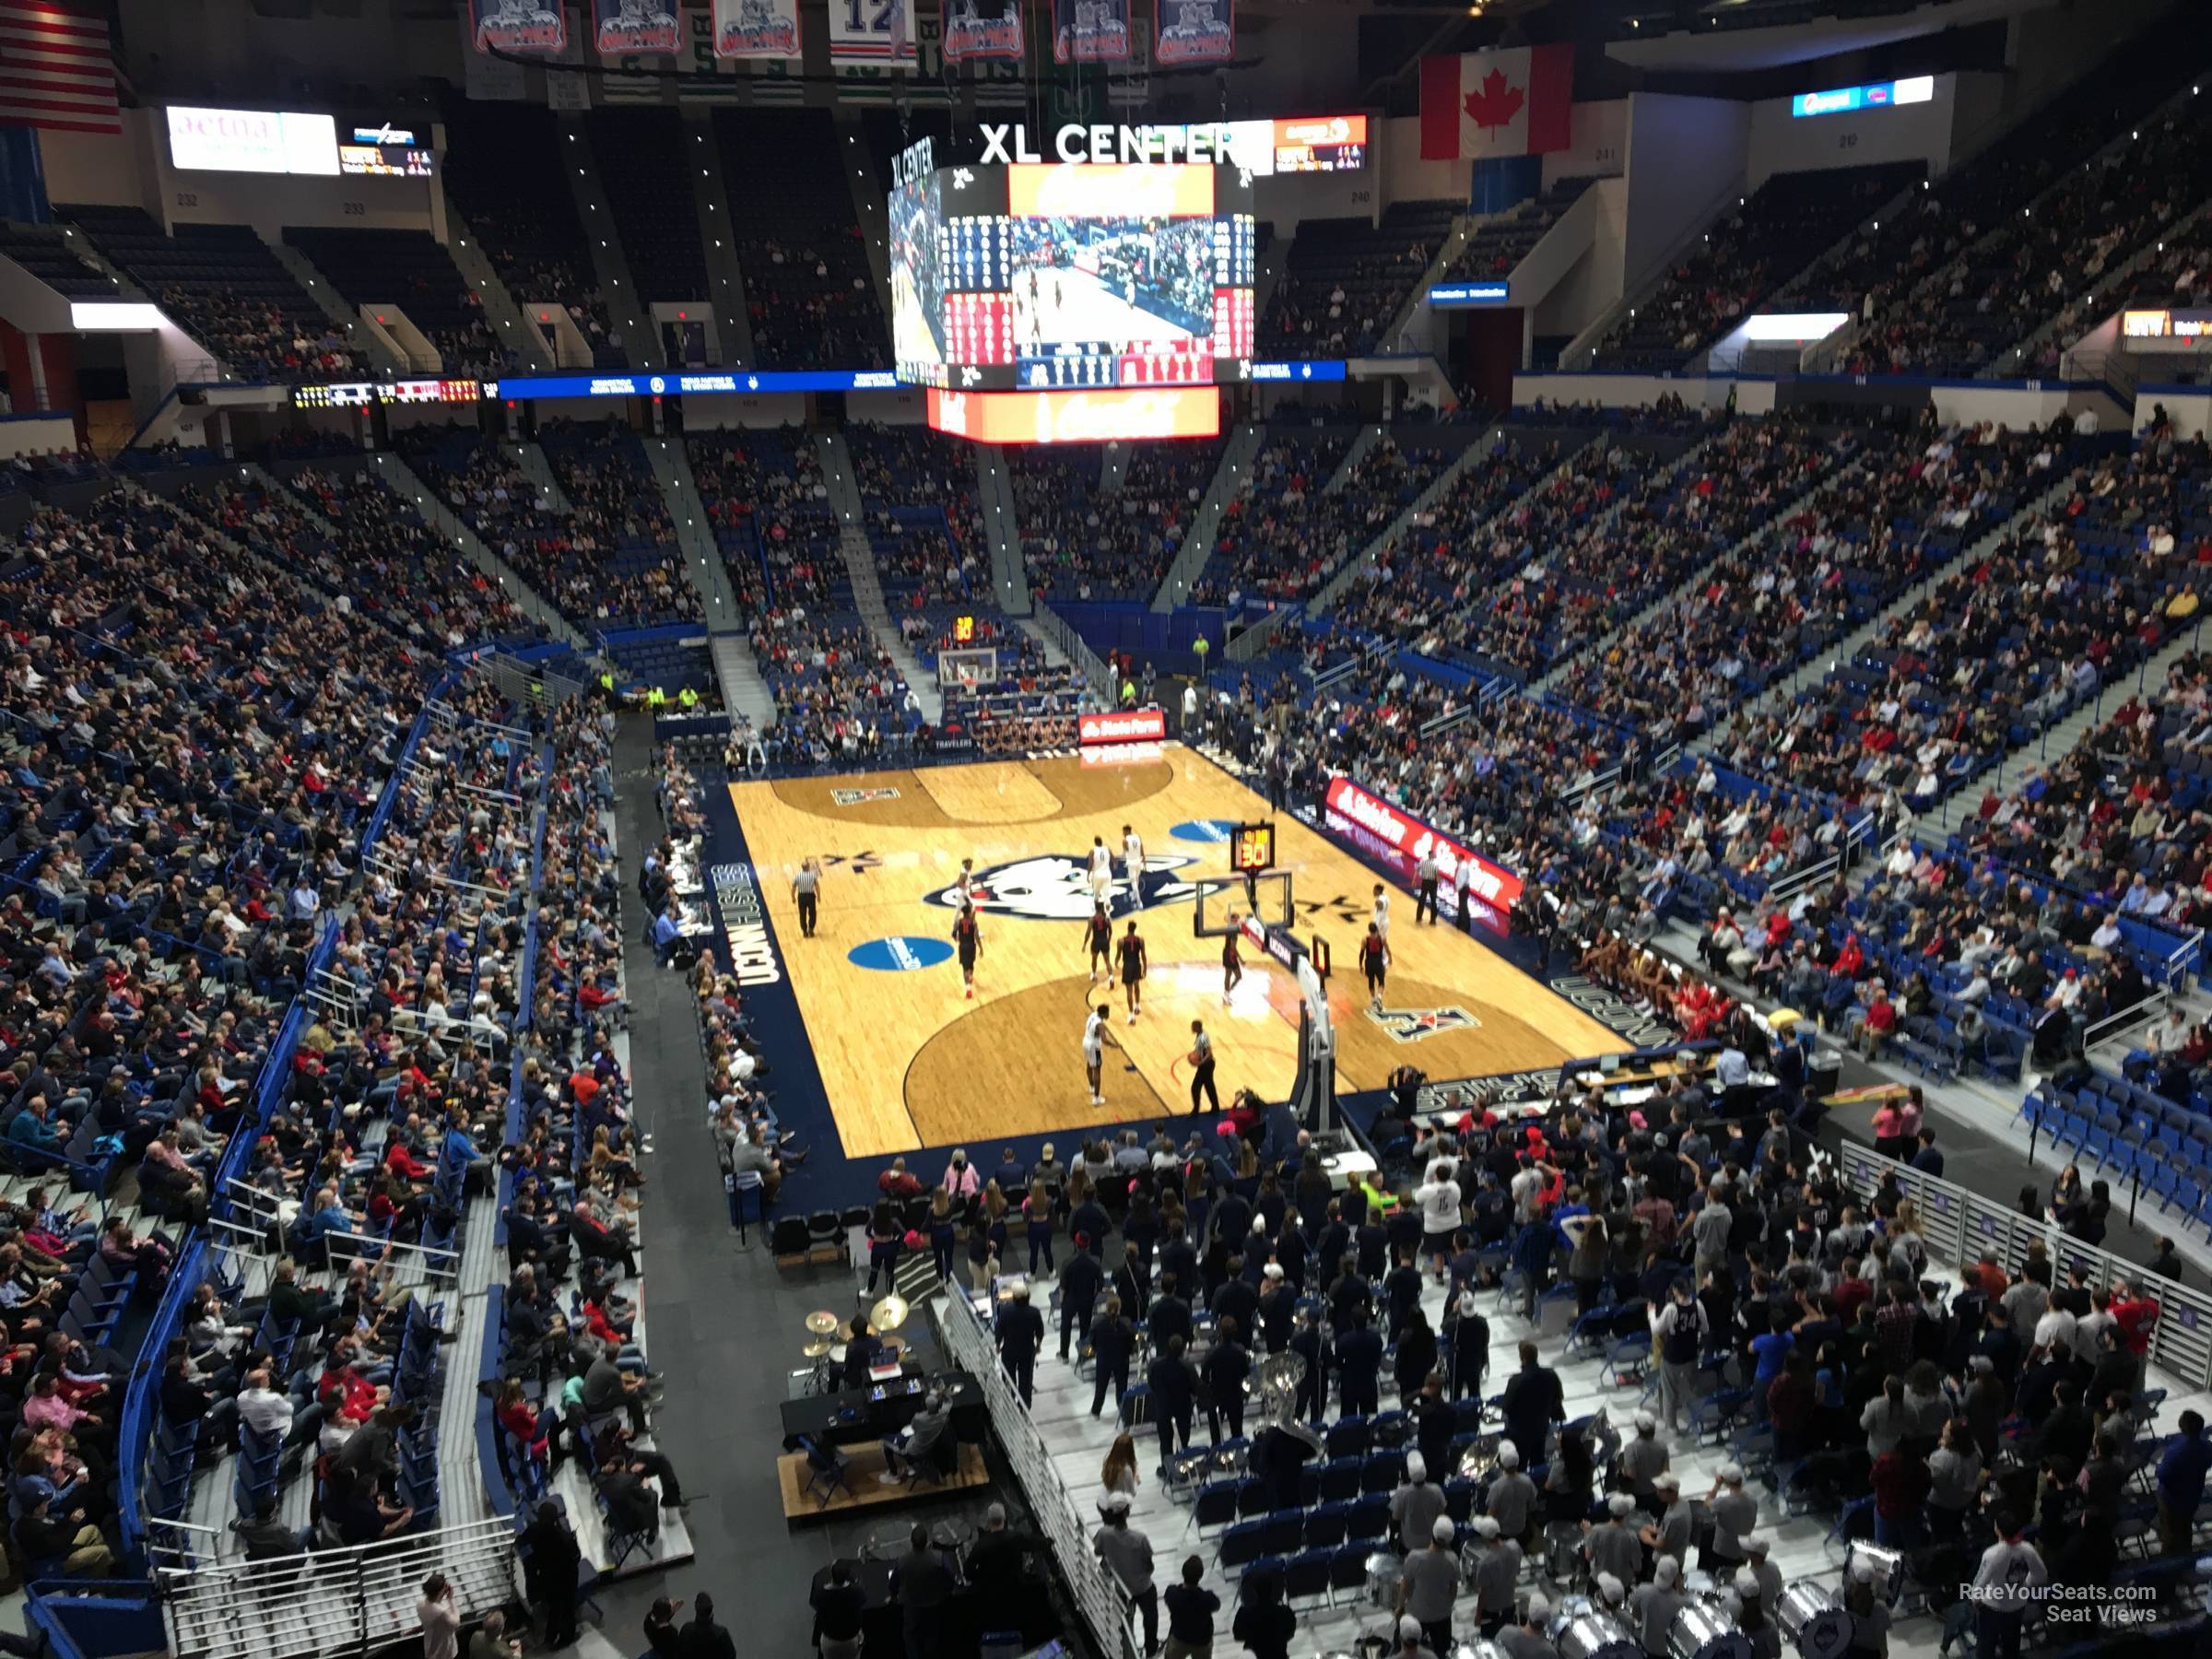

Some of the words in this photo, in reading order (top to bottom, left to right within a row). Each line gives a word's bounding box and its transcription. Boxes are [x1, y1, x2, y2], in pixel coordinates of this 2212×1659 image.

[979, 124, 1041, 163] XL
[1055, 124, 1236, 164] CENTER
[891, 153, 903, 190] XL
[903, 135, 934, 184] CENTER
[935, 738, 972, 749] TRAVELERS
[1241, 842, 1265, 868] 30
[730, 922, 781, 986] UCONN
[1269, 935, 1291, 967] UCONN
